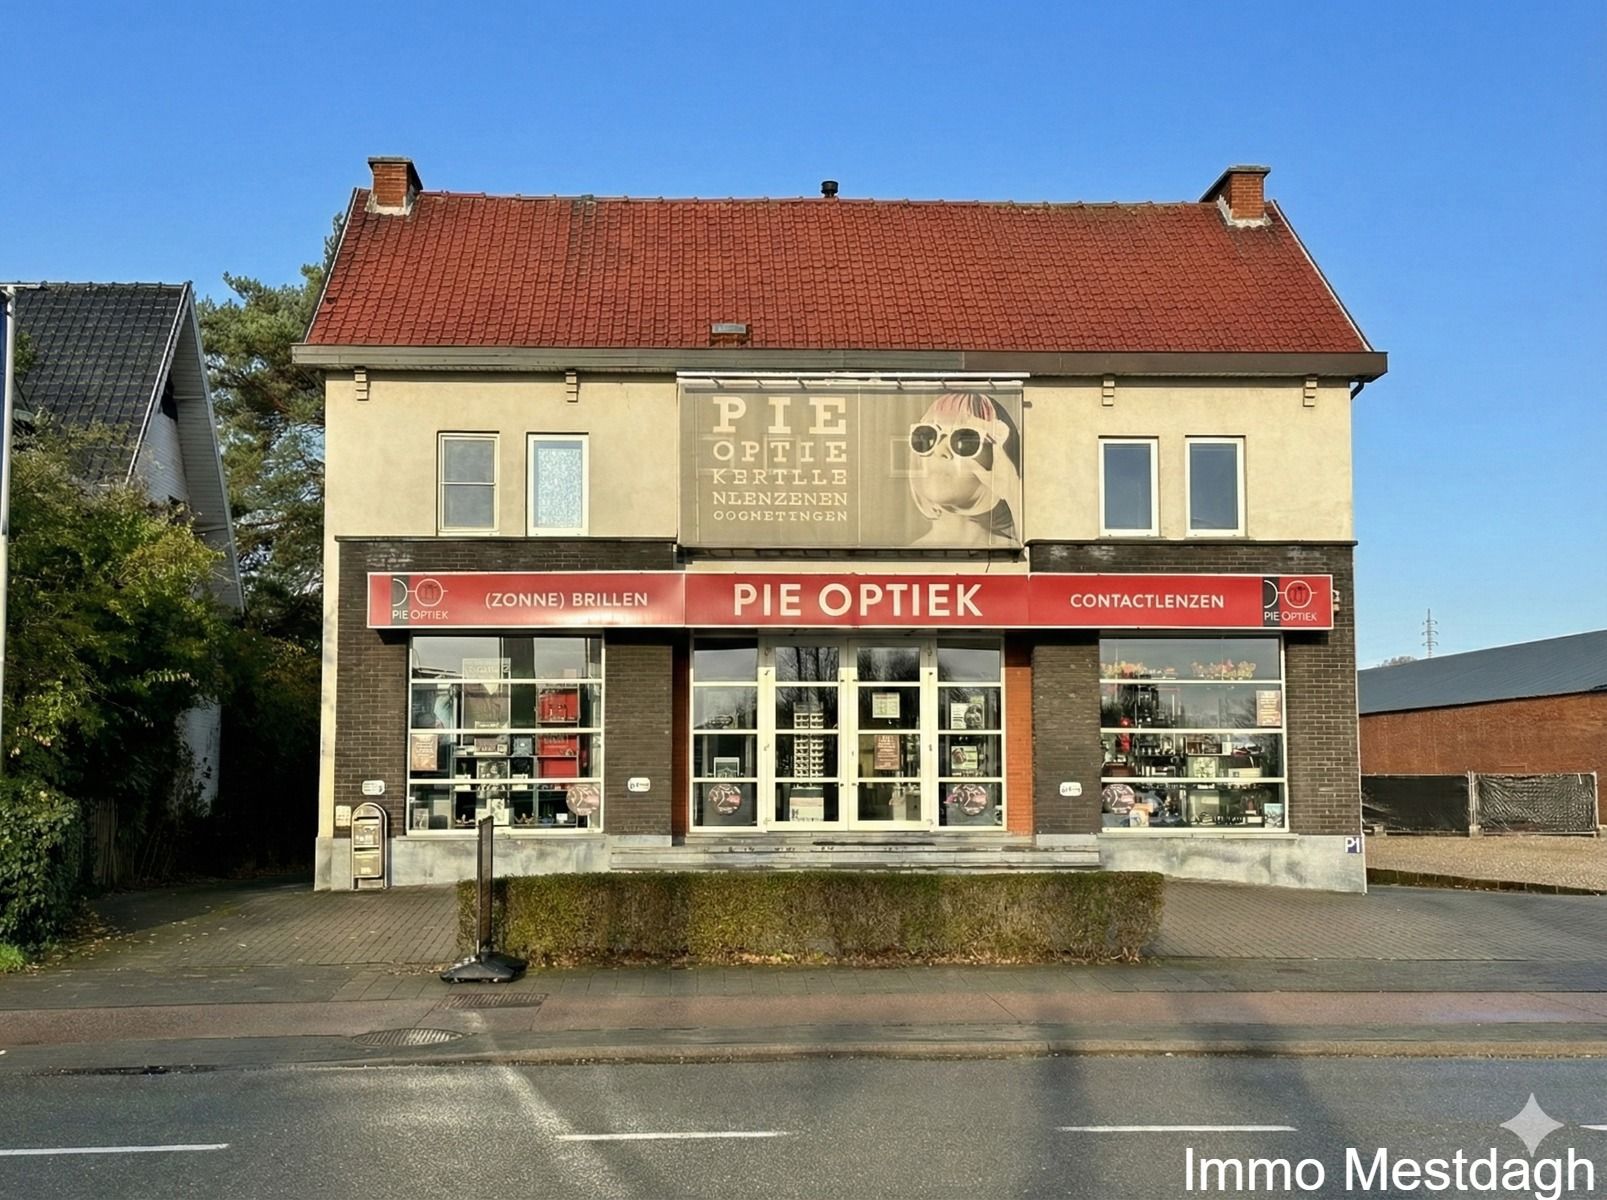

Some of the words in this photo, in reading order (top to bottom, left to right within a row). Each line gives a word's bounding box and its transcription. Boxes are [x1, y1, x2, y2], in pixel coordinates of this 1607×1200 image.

[713, 396, 847, 434] PIE
[713, 441, 847, 462] OPTIE
[712, 491, 848, 506] NLENZENEN
[484, 592, 565, 609] (ZONNE)
[572, 593, 648, 607] BRILLEN
[733, 583, 802, 616] PIE
[818, 582, 984, 617] OPTIEK
[1070, 593, 1225, 609] CONTACTLENZEN
[392, 609, 409, 620] PIE
[410, 609, 449, 620] OPTIEK
[1264, 611, 1280, 621] PIE
[1281, 610, 1318, 621] OPTIEK
